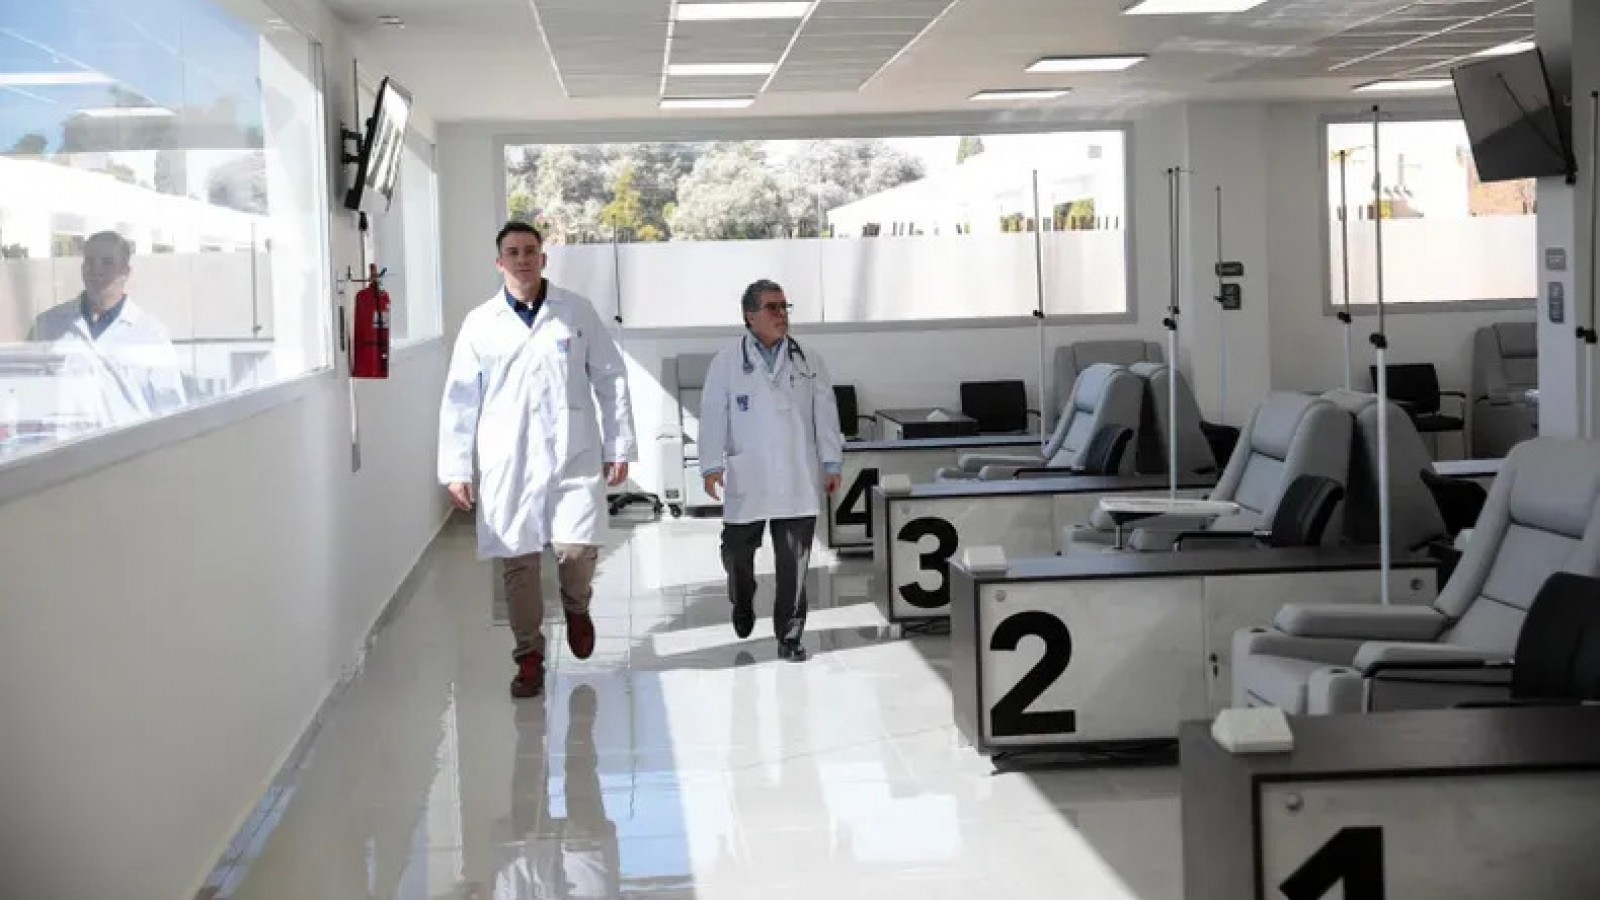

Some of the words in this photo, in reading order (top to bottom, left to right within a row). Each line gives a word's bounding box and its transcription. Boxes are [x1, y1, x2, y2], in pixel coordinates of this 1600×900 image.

[836, 468, 879, 538] 4
[897, 517, 959, 608] 3
[990, 610, 1076, 737] 2
